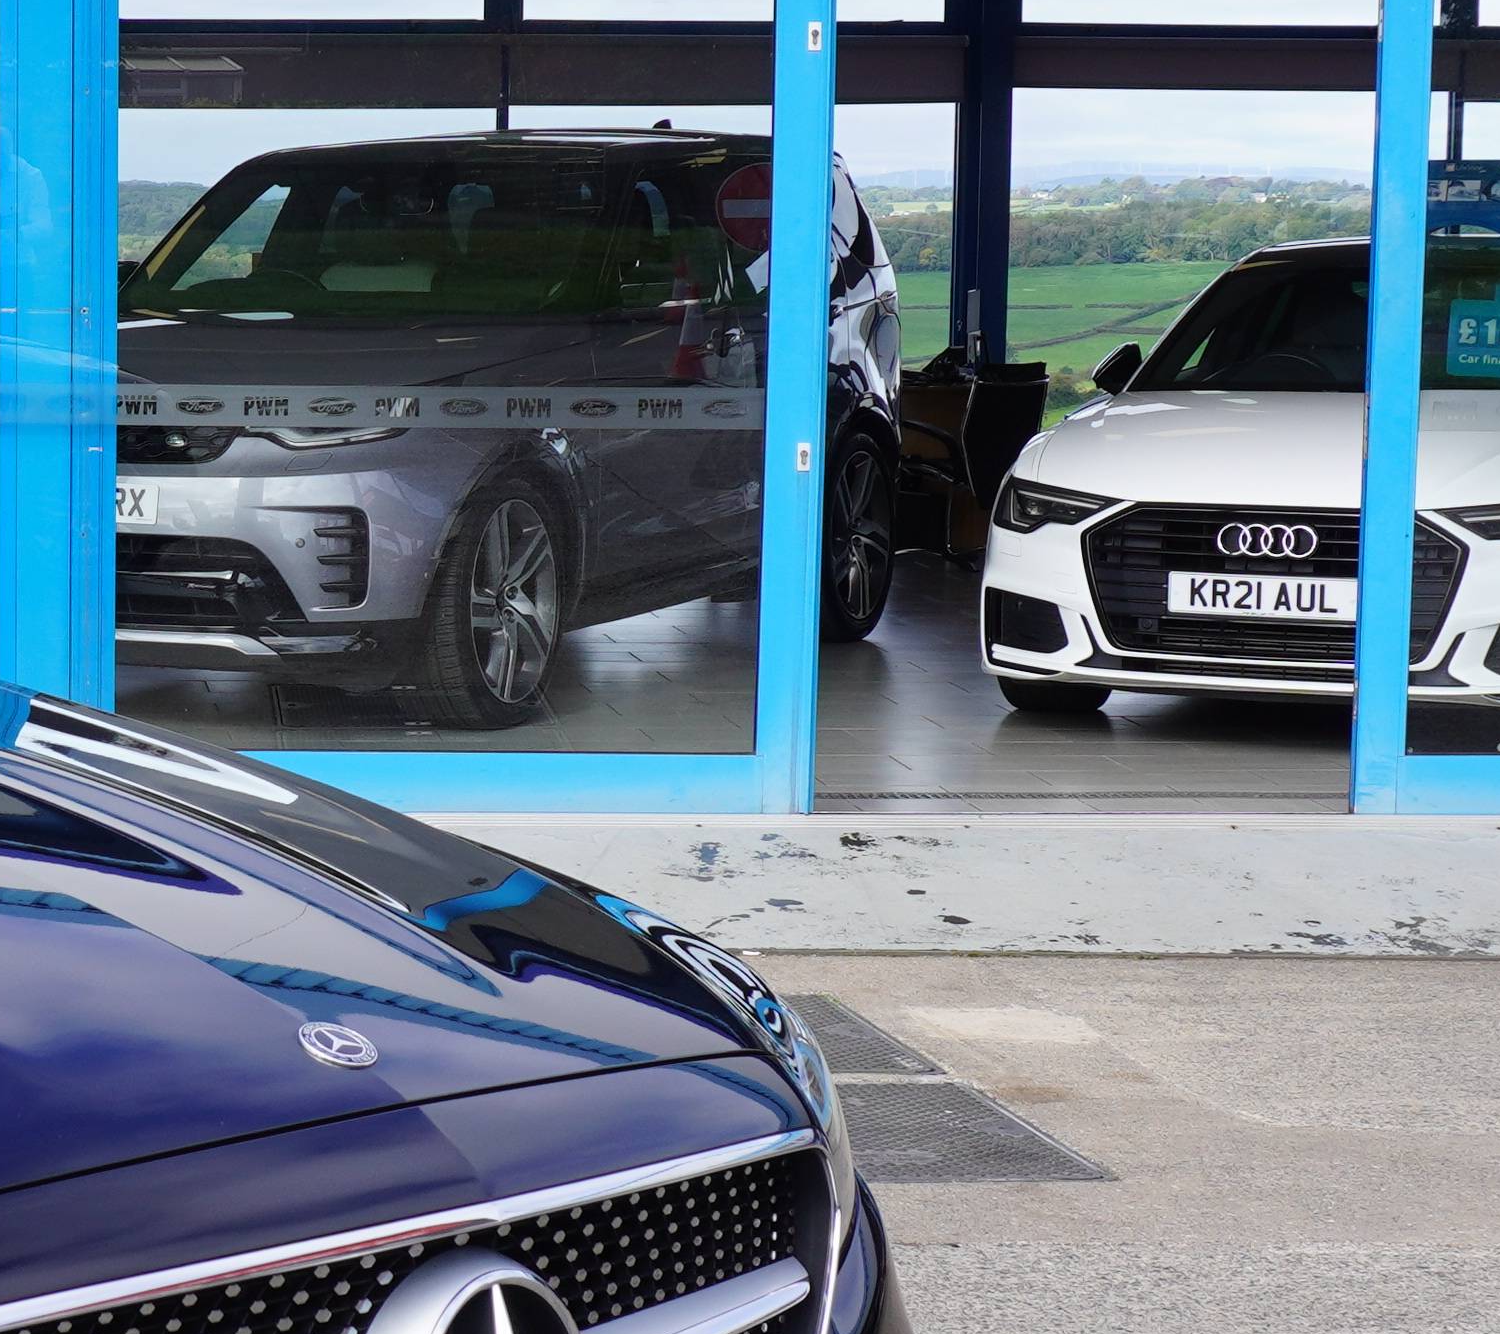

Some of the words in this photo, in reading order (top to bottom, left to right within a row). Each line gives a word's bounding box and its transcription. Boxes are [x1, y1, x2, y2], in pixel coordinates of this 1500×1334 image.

[1458, 354, 1479, 364] Car
[243, 395, 289, 416] PWM
[375, 396, 421, 418] PWM
[506, 397, 552, 419] PWM
[637, 398, 683, 419] PWM
[1189, 578, 1262, 610] KR21
[1273, 582, 1338, 614] AUL
